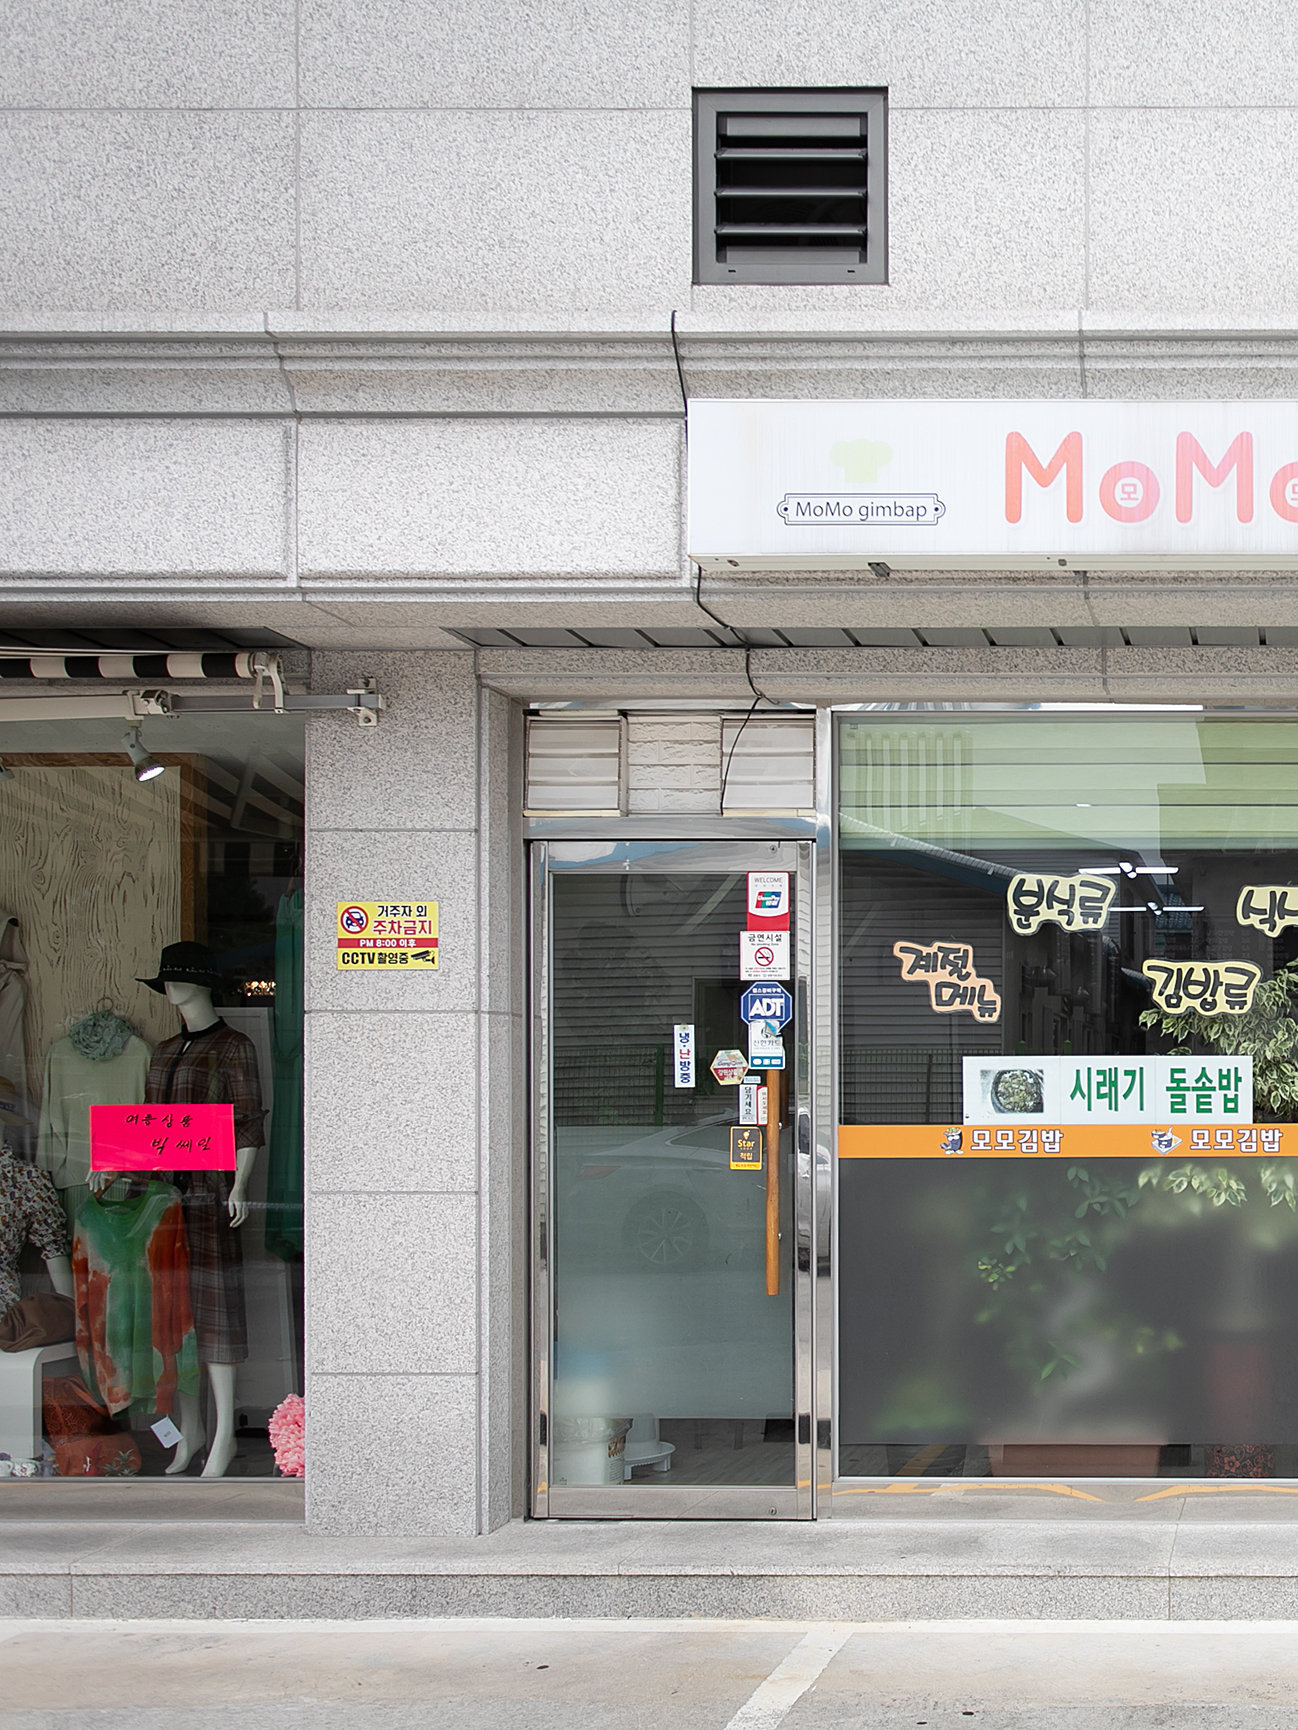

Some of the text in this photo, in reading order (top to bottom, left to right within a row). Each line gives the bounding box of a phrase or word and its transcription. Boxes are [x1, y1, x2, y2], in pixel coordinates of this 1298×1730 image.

[1120, 483, 1139, 501] 모
[795, 500, 927, 522] MoMo gimbap
[377, 905, 427, 917] 거주자 외
[1012, 877, 1112, 930] 분식류
[373, 920, 432, 936] 주차금지
[359, 939, 417, 948] PM 8:00 이후
[748, 933, 782, 943] 금연시설
[341, 952, 376, 965] CCTV
[1147, 965, 1257, 1012] 김밥류
[749, 998, 785, 1017] ADT
[935, 981, 997, 1018] 메뉴
[753, 1039, 781, 1047] 신한카드
[1070, 1066, 1242, 1114] 시래기 돌솥밥
[744, 1086, 752, 1114] 당기세요
[737, 1139, 756, 1148] Star
[970, 1129, 1283, 1153] 모모김밥 모모김밥
